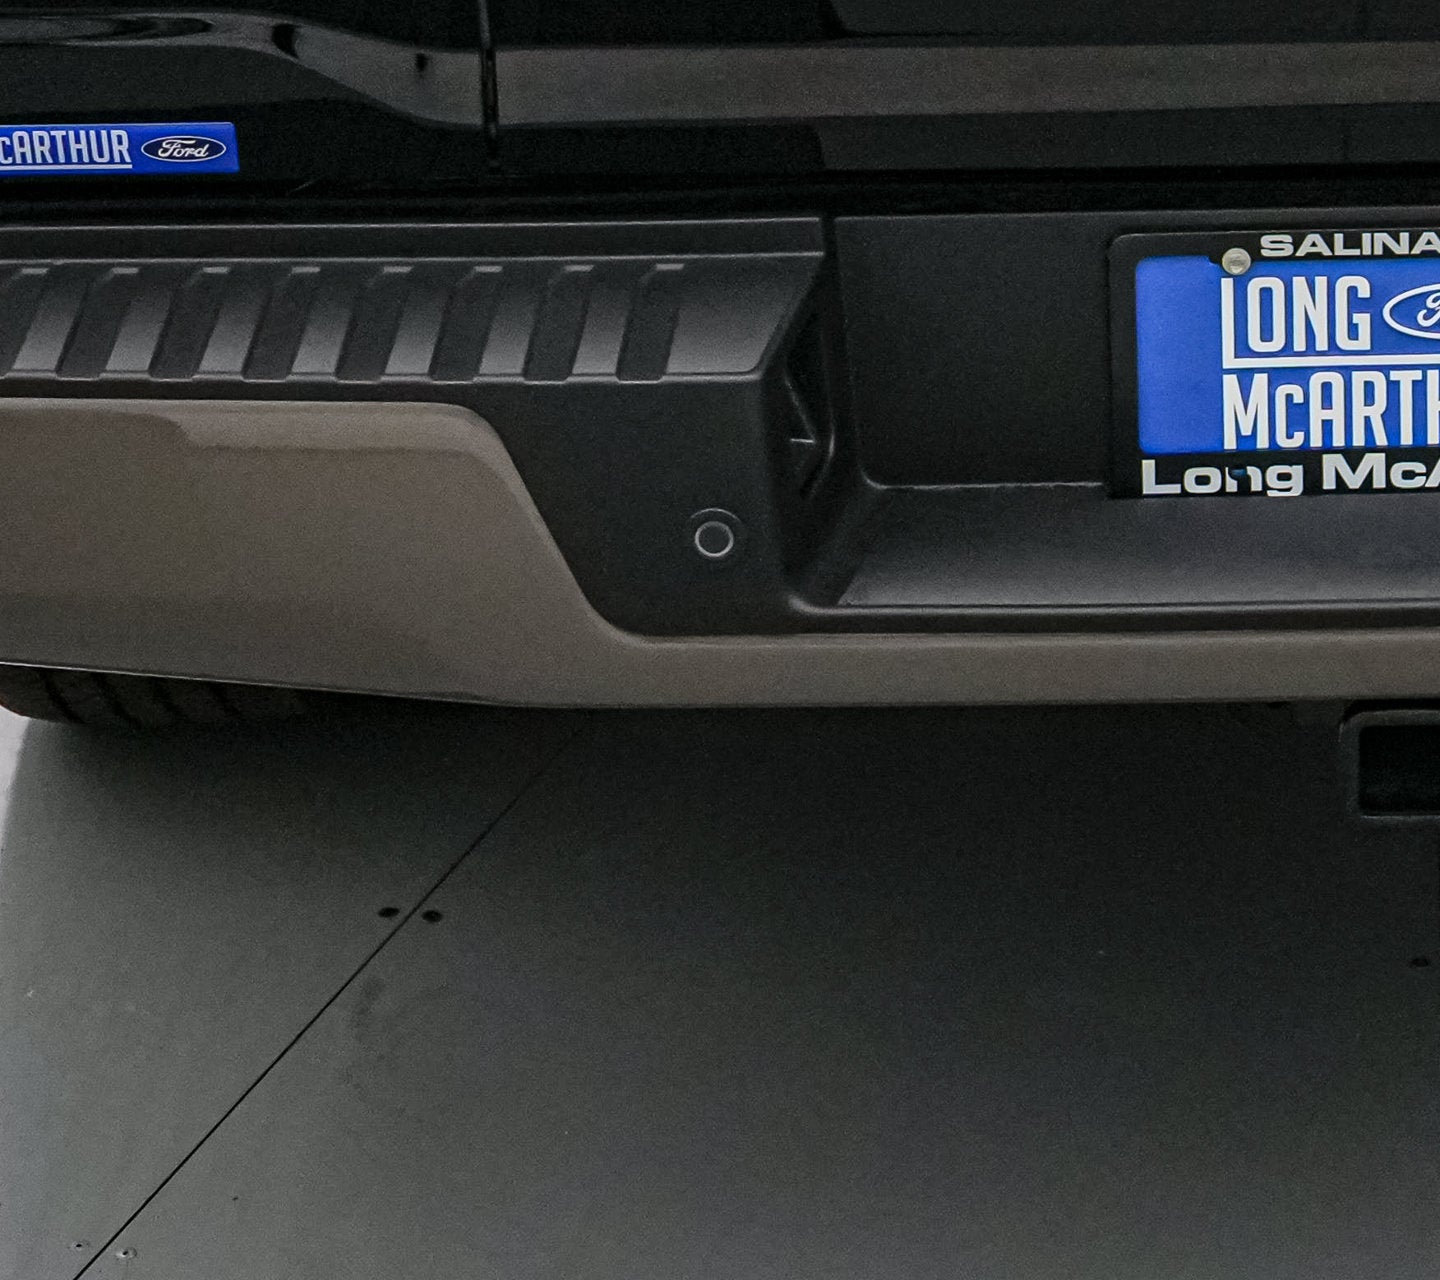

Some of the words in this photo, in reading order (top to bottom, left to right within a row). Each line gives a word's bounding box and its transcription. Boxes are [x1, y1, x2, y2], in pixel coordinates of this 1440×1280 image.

[157, 139, 210, 159] Ford
[1221, 276, 1371, 369] LONG
[1141, 458, 1304, 497] Long
